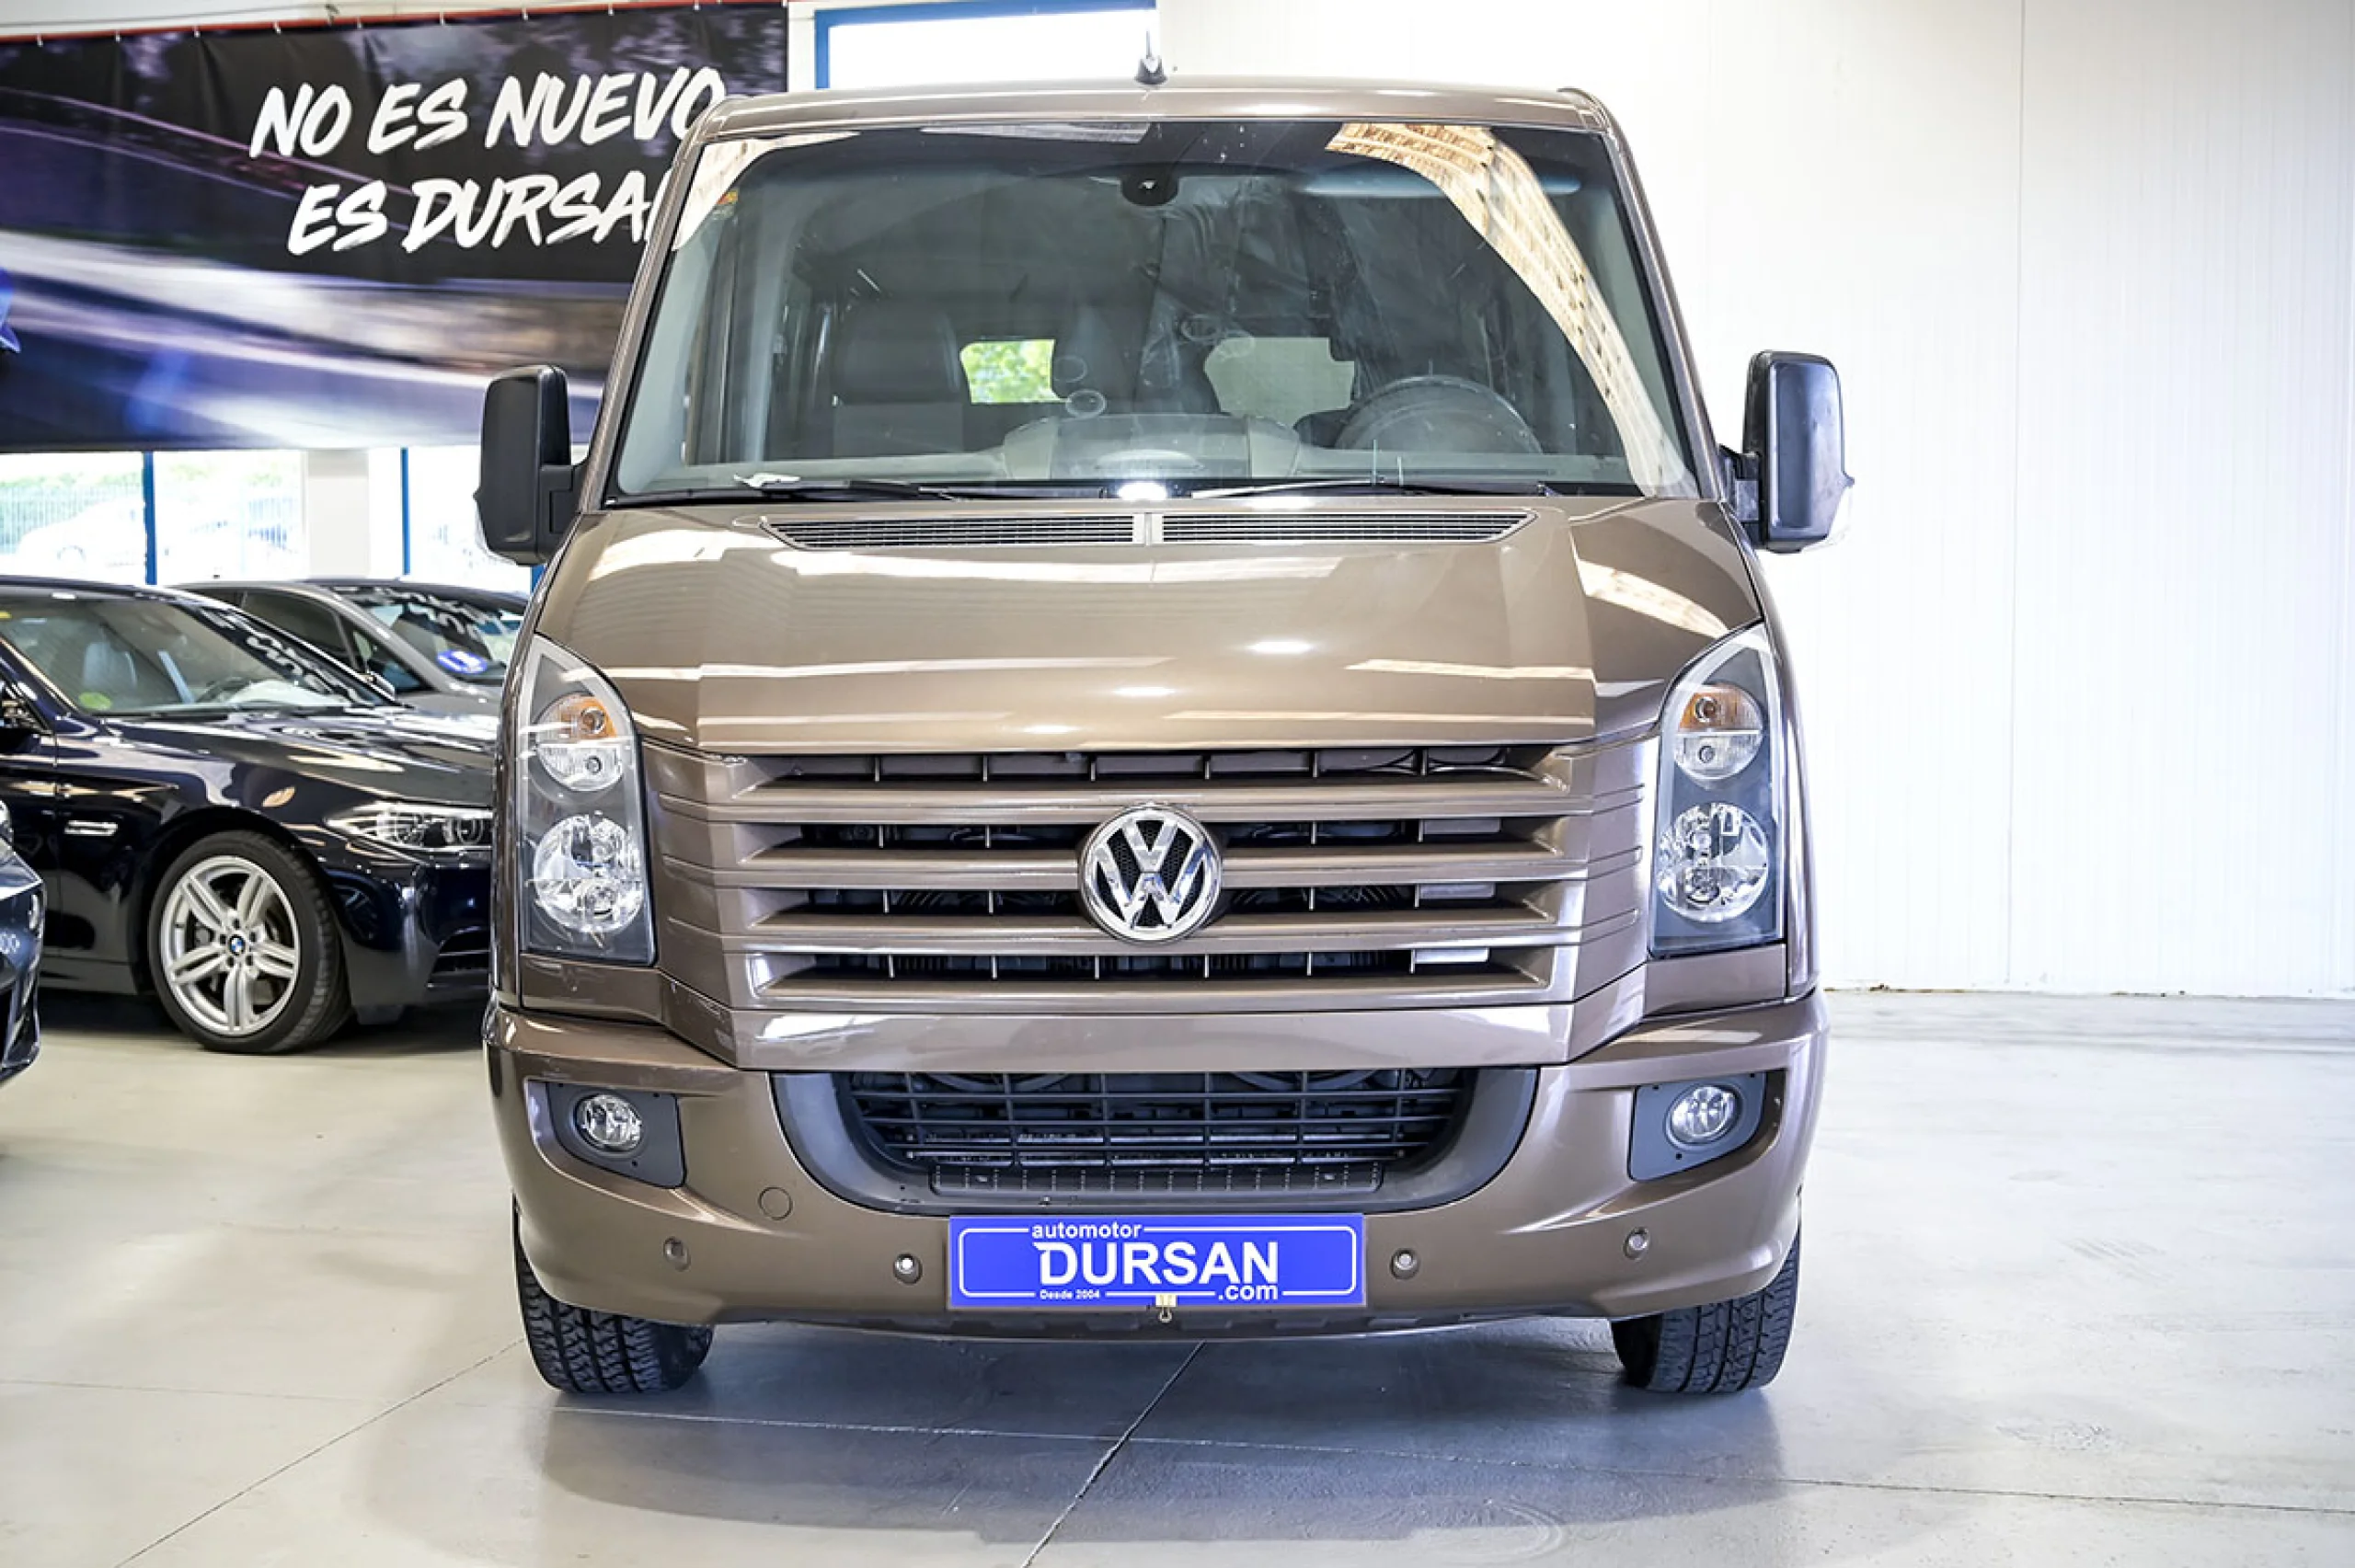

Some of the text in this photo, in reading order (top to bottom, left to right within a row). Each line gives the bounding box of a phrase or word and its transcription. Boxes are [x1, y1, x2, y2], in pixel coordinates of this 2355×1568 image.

[249, 66, 726, 158] NO ES NUEVO
[287, 182, 390, 256] ES
[1032, 1221, 1142, 1239] automotor
[1032, 1242, 1279, 1285] DURSAN
[1218, 1285, 1279, 1300] .com
